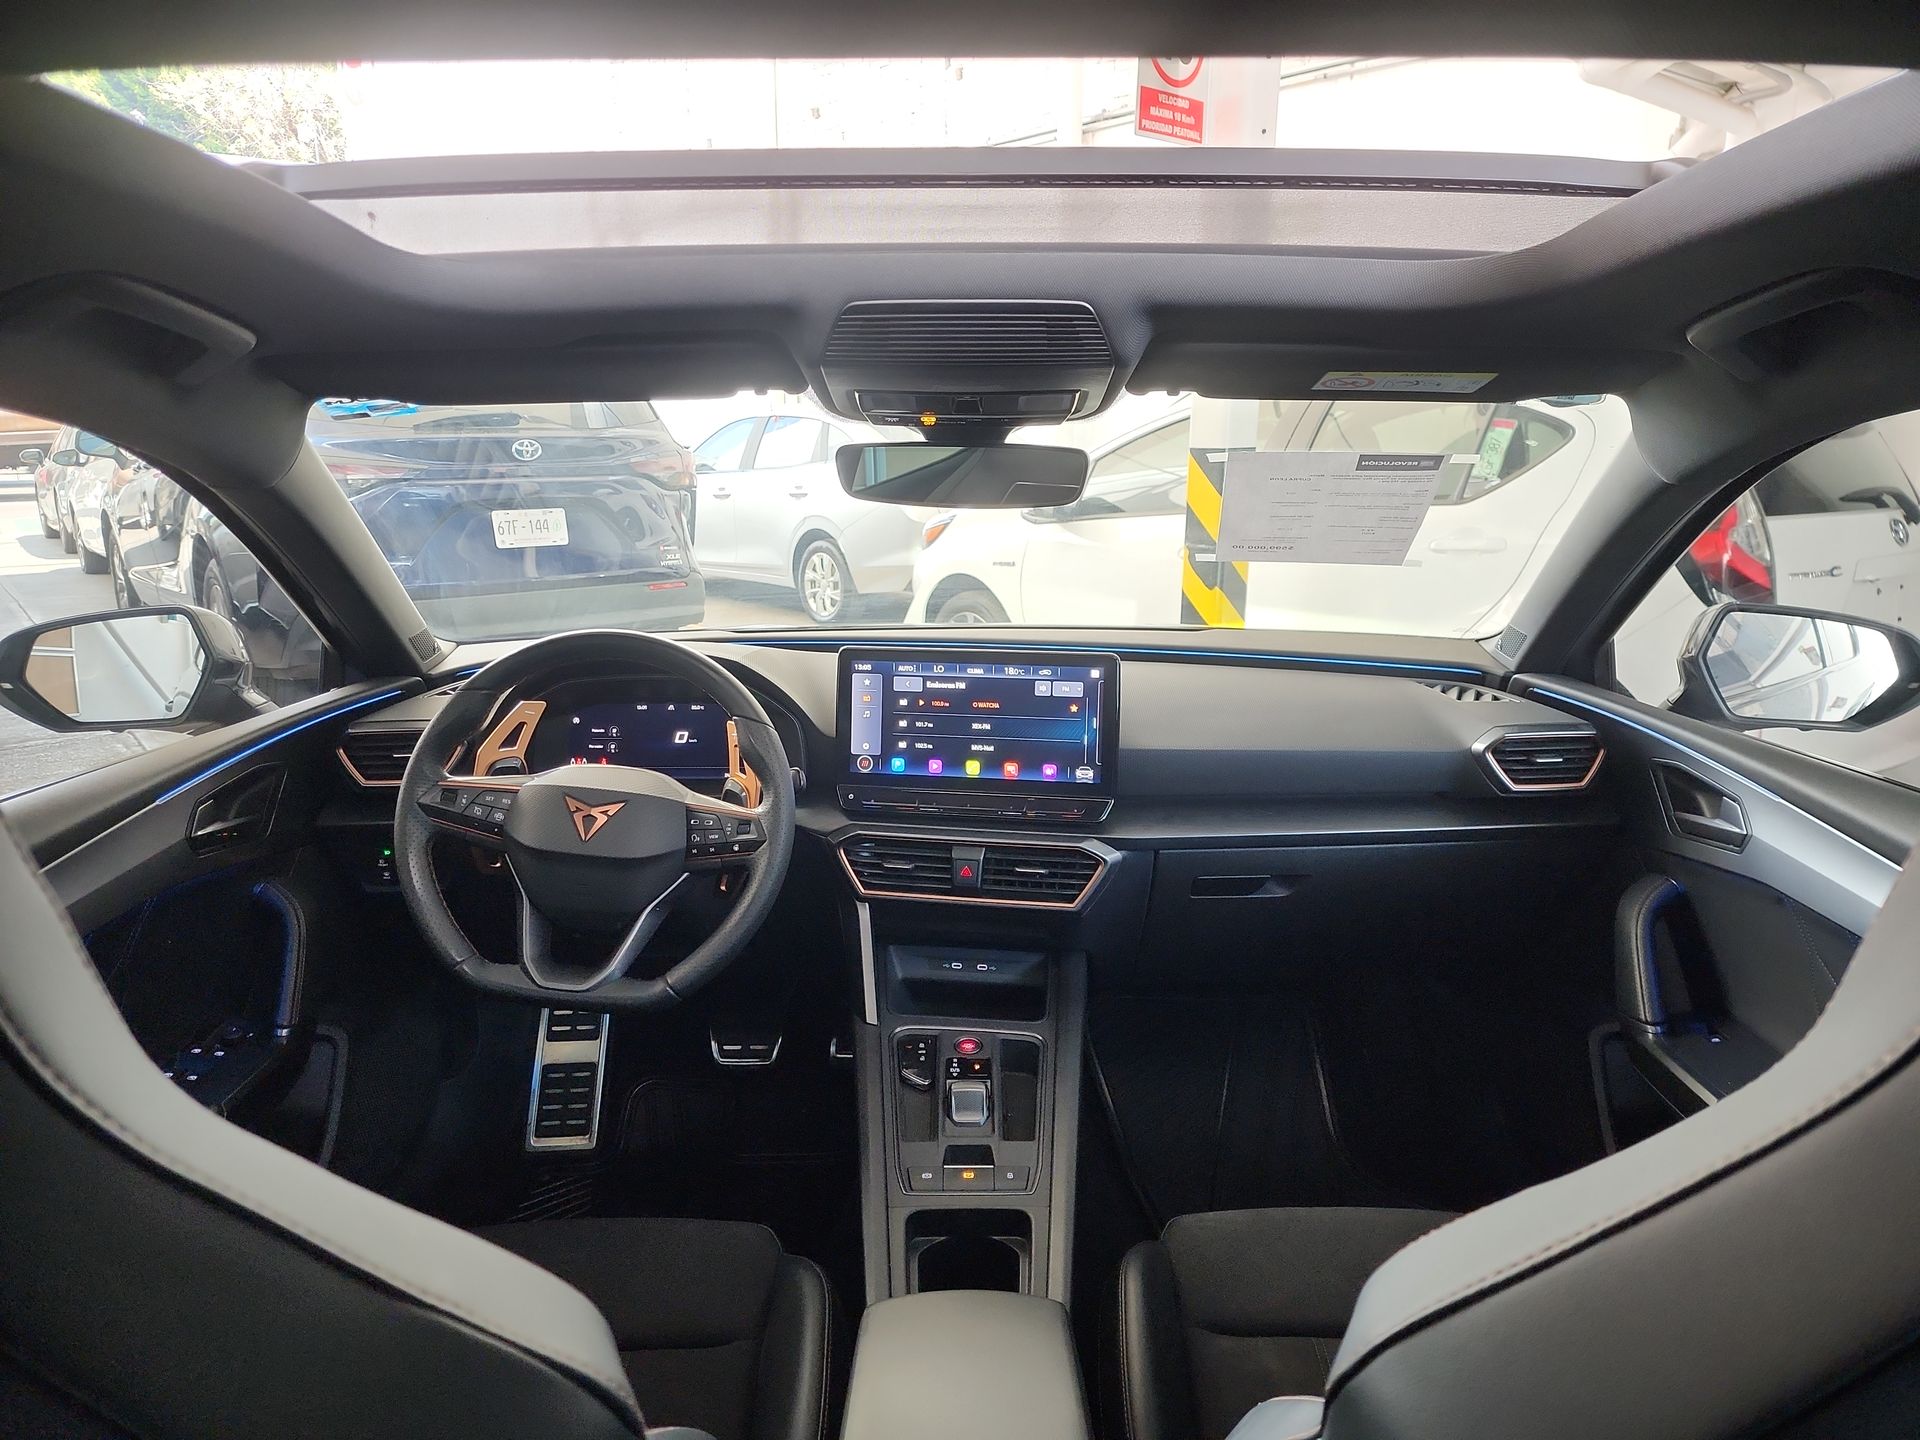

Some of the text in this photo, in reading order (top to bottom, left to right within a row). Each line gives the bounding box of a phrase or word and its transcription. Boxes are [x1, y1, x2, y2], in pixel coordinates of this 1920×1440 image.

[1158, 93, 1190, 109] VELOCIDAD
[1141, 118, 1200, 141] PRIORIDAD PEATONAL
[497, 518, 550, 536] 67F-144
[926, 681, 955, 689] Emisoras
[674, 731, 689, 743] 0
